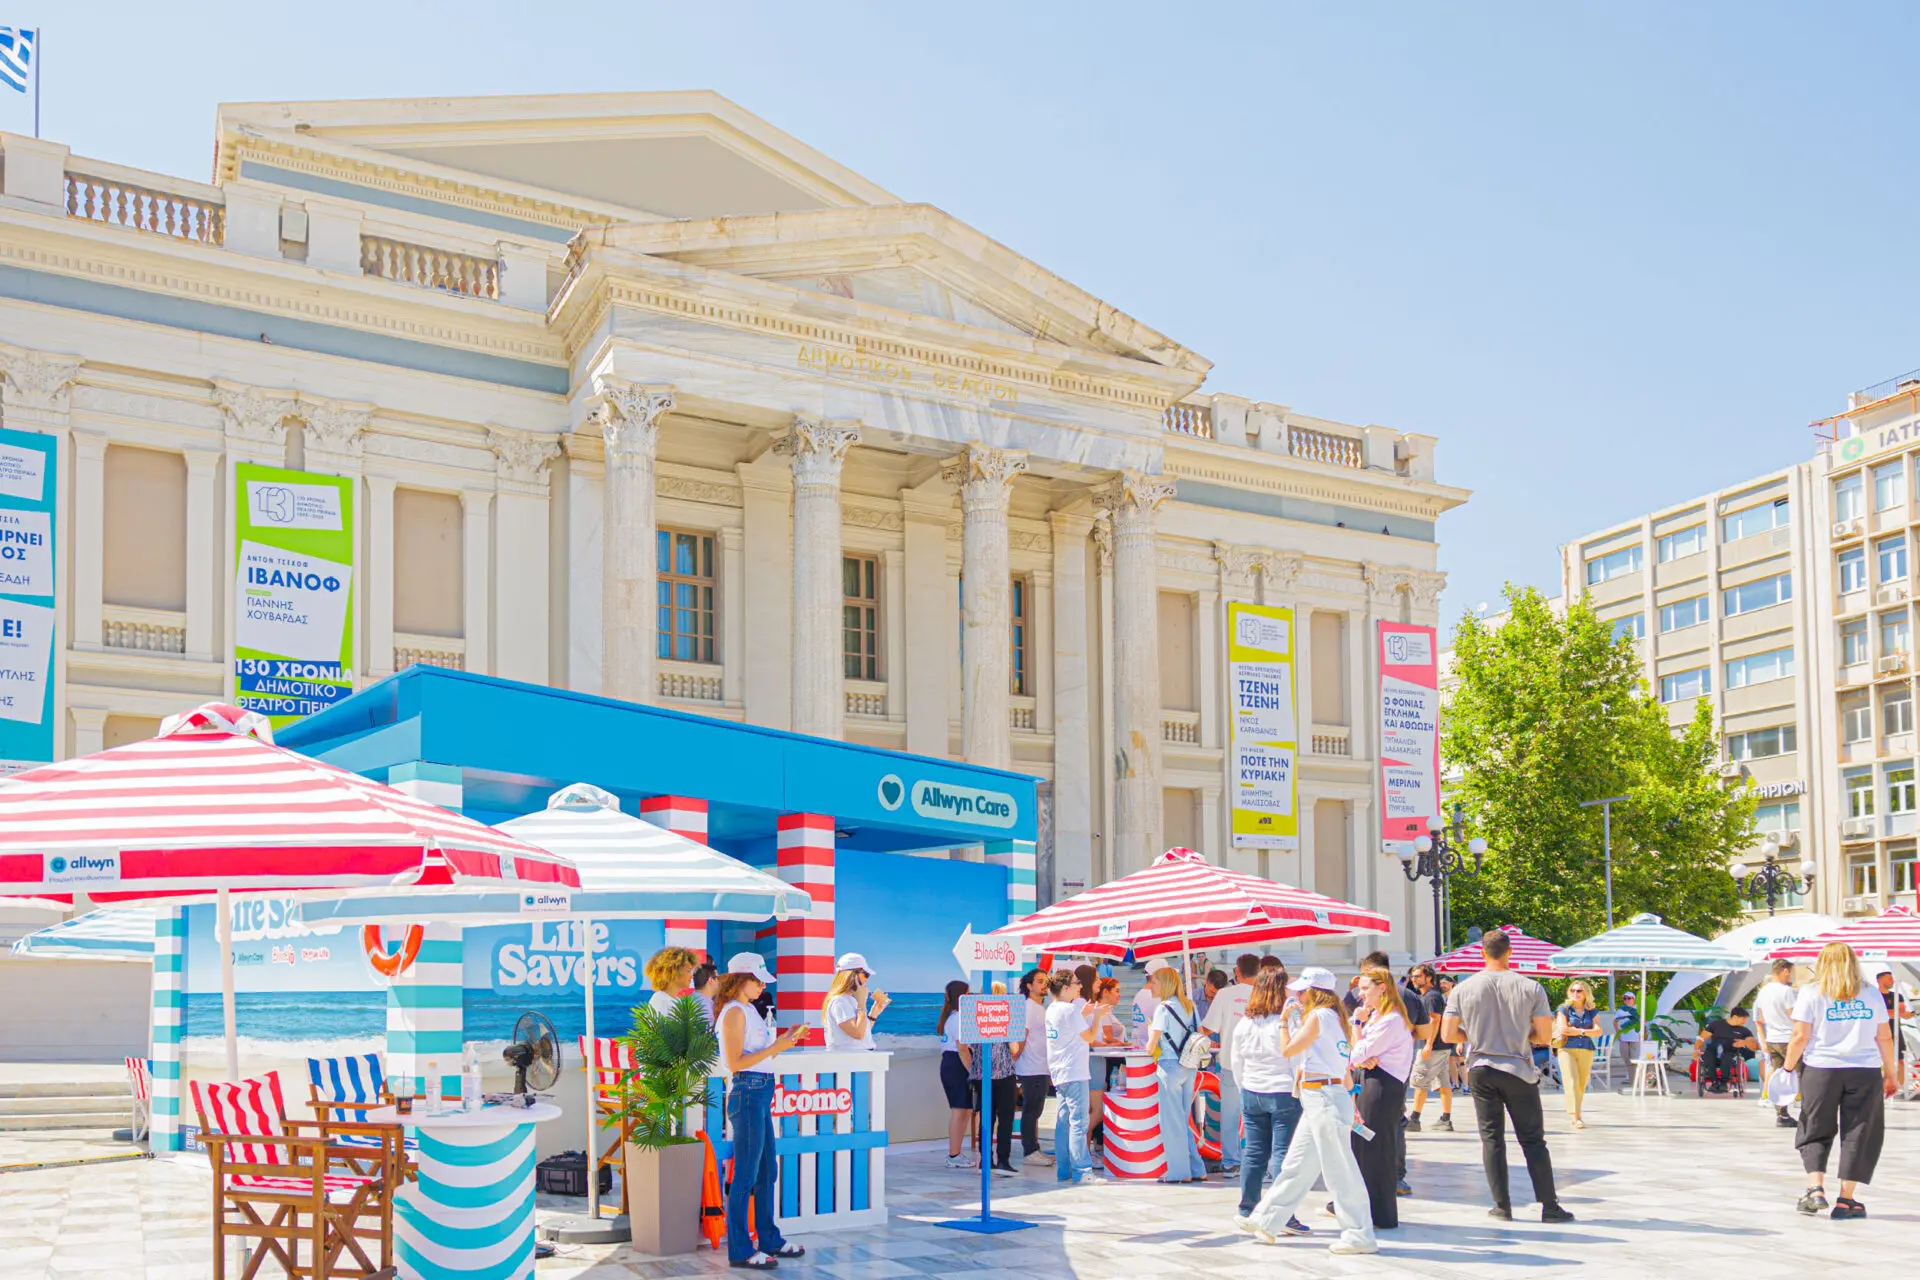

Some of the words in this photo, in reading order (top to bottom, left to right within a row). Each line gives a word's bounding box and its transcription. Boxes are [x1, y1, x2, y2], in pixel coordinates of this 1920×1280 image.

[797, 345, 911, 381] ΔΗΜΟΤΙΚΟΝ
[248, 567, 340, 592] ΙΒΑΝΟΦ
[247, 597, 294, 610] ΓΙΑΝΝΗΣ
[247, 610, 308, 624] ΧΟΥΒΑΡΔΑΣ
[235, 659, 270, 676] 130
[275, 661, 353, 682] ΧΡΟΝΙΑ
[255, 679, 336, 698] ΔΗΜΟΤΙΚΟ
[1239, 680, 1279, 695] ΤΖΕΝΗ
[235, 695, 295, 712] ΘΕΑΤΡΟ
[1239, 695, 1279, 710] ΤΖΕΝΗ
[1384, 707, 1420, 719] ΕΓΚΛΗΜΑ
[1384, 719, 1397, 728] ΚΑΙ
[1399, 720, 1434, 732] ΑΘΩΩΣΗ
[1241, 755, 1267, 767] ΠΟΤΕ
[1269, 757, 1289, 769] ΤΗΝ
[1241, 768, 1286, 783] ΚΥΡΙΑΚΗ
[921, 786, 972, 816] Allwyn
[976, 795, 1010, 817] Care
[70, 856, 115, 871] allwyn
[537, 896, 567, 905] allwyn
[498, 944, 637, 987] Savers
[1836, 1000, 1865, 1010] Life
[1827, 1008, 1872, 1020] Savers
